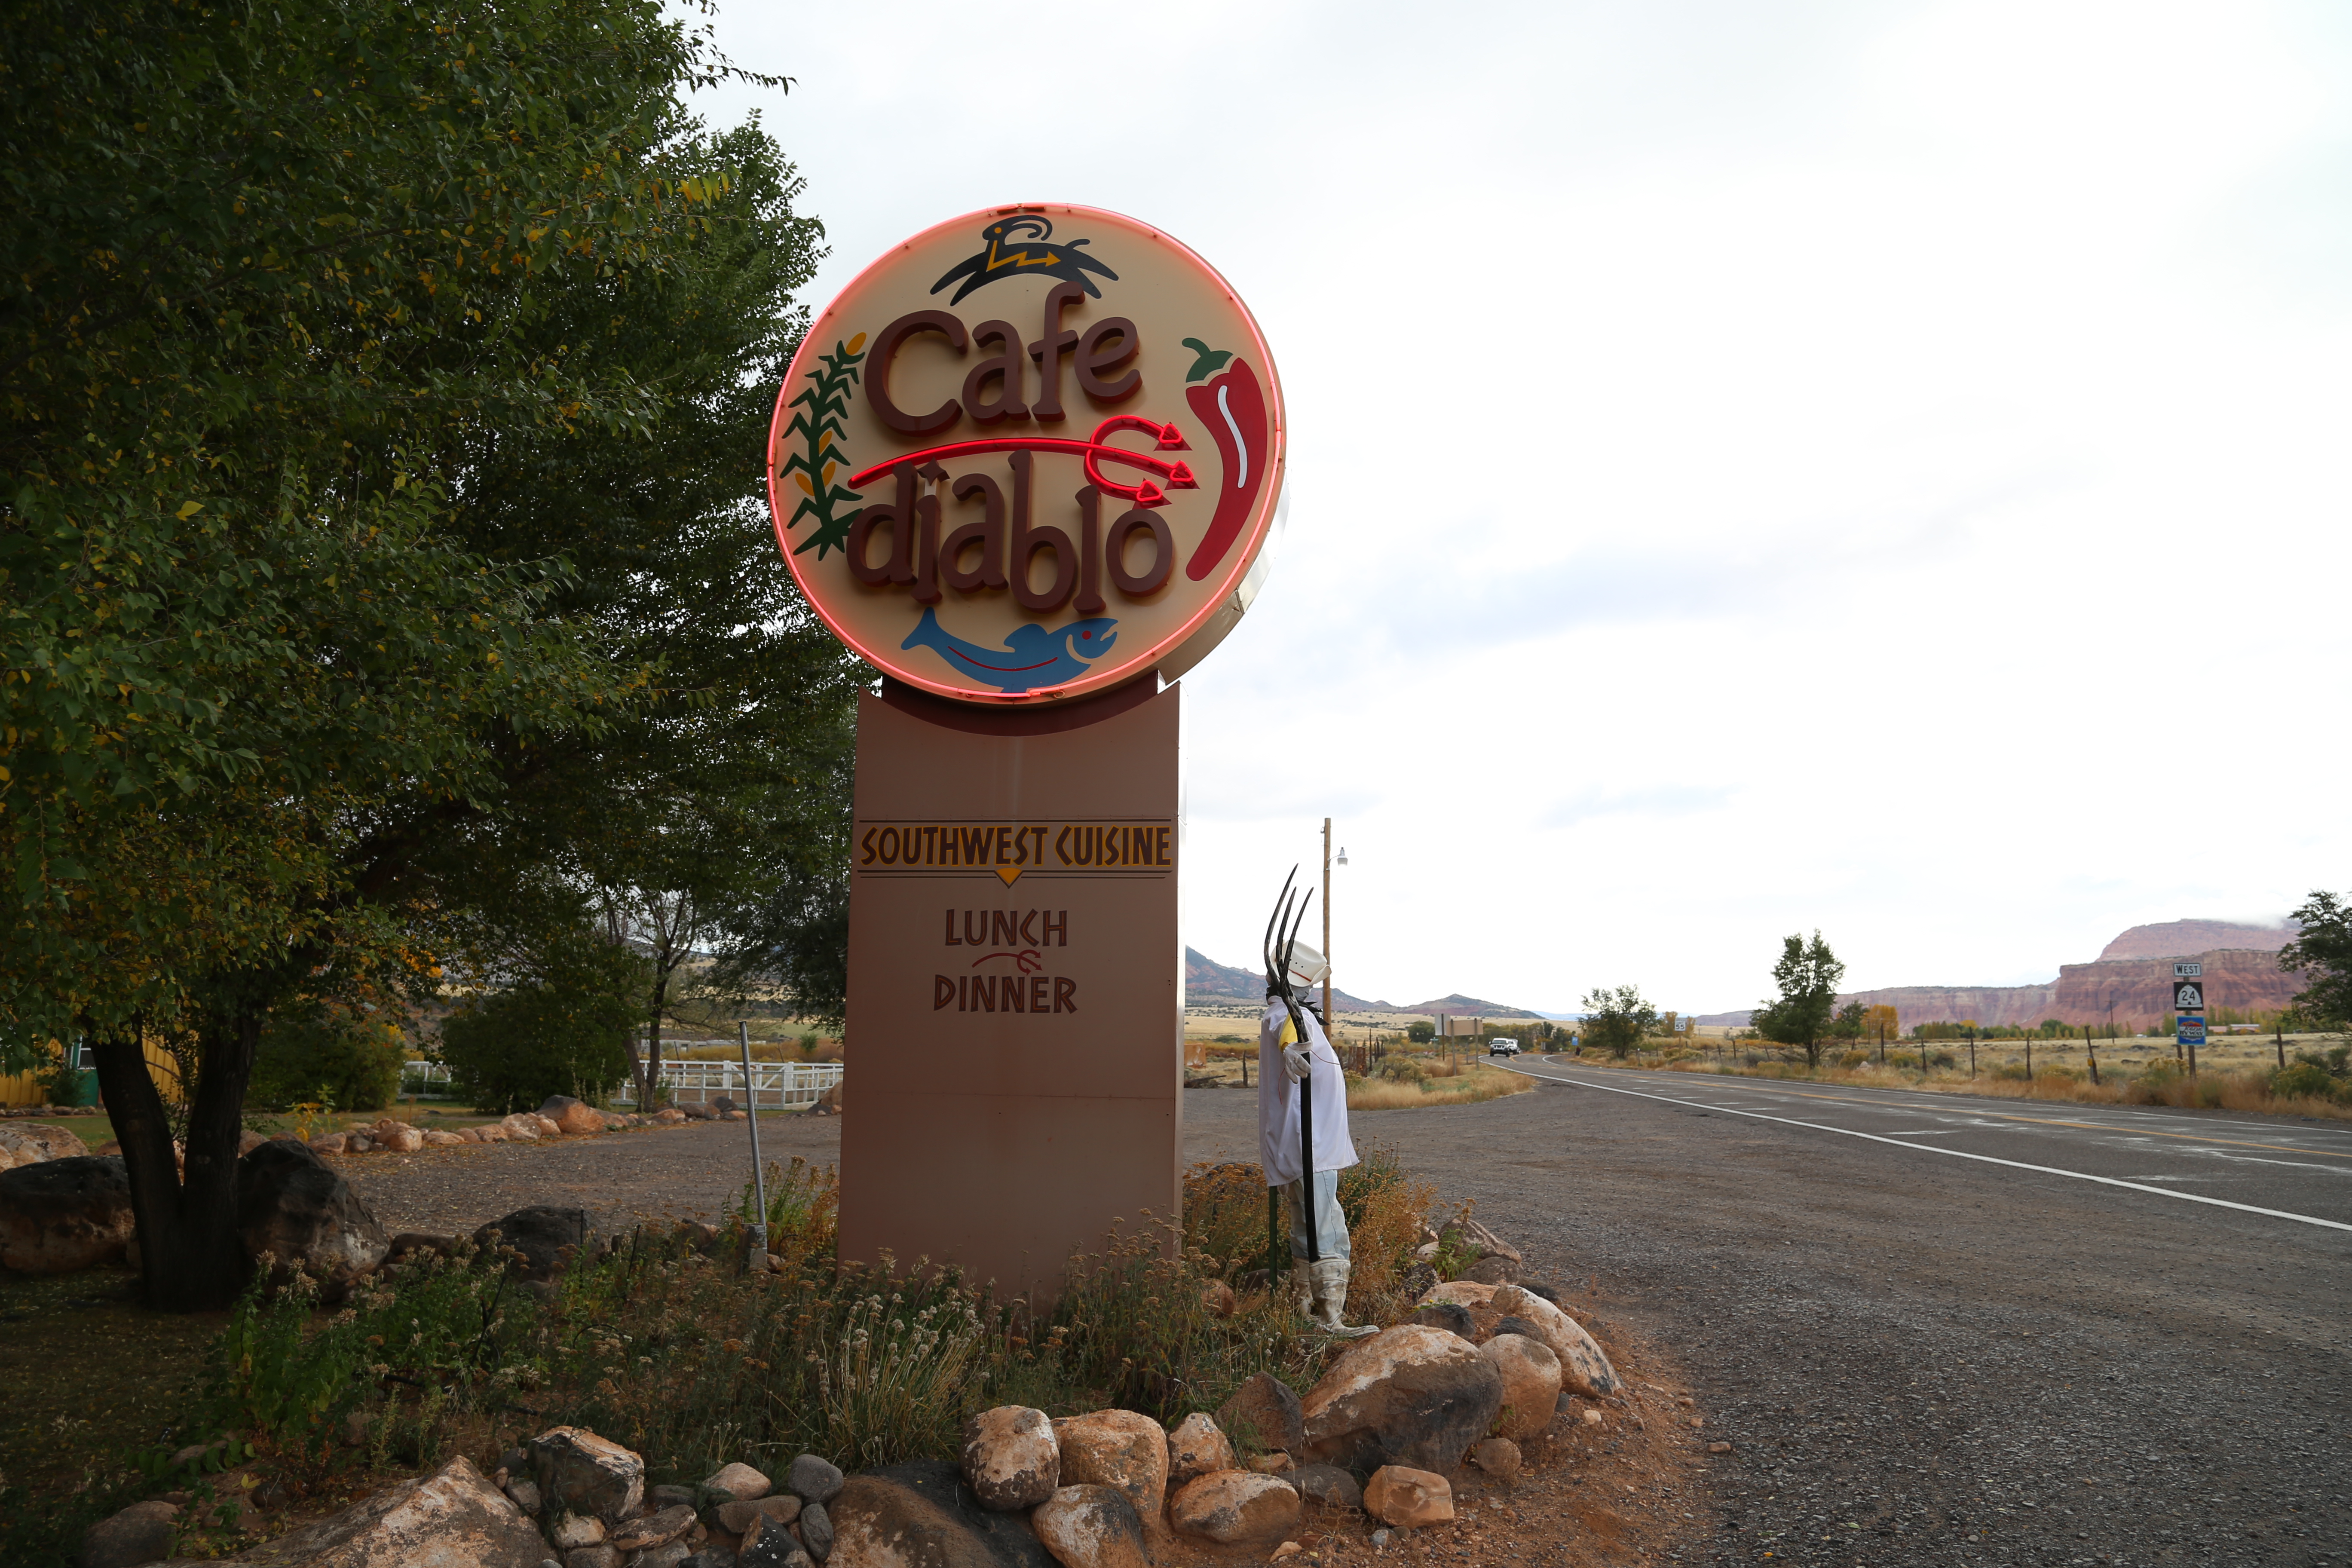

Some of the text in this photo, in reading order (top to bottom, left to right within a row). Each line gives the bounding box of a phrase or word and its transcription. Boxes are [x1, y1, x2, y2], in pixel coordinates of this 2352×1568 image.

[864, 281, 1143, 438] Cafe
[845, 448, 1176, 615] diablo
[860, 824, 1172, 867] SOUTHWEST CUISINE
[945, 908, 1068, 947] LUNCH
[2176, 965, 2198, 974] WEST
[934, 974, 1078, 1014] DINNER
[2181, 990, 2195, 1001] 24
